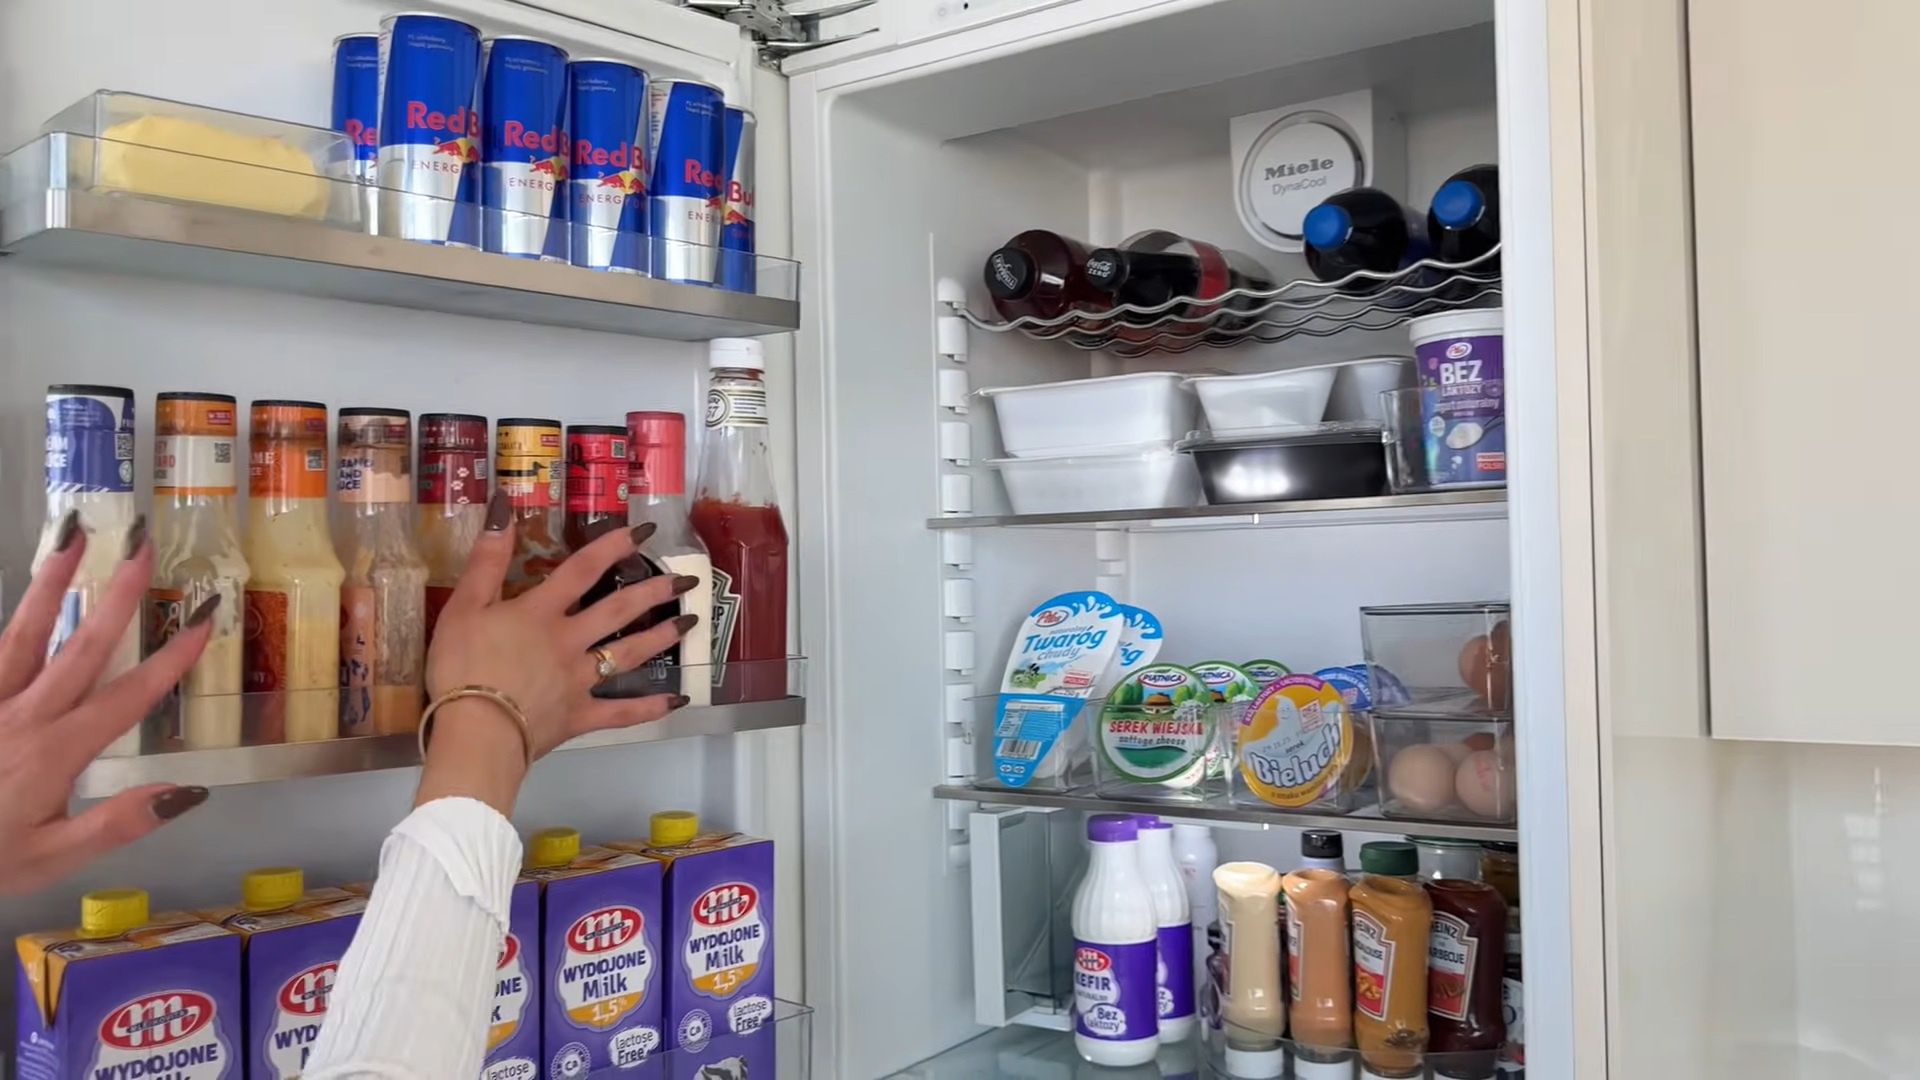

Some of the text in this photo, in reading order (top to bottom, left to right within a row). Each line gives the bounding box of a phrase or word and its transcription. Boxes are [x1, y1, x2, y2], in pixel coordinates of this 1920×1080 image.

[345, 118, 376, 145] Re
[412, 158, 459, 174] ENERG
[1264, 158, 1335, 181] Miele
[509, 177, 553, 191] ENERG
[729, 181, 755, 208] Bul
[1272, 175, 1327, 197] DynaCool
[581, 194, 622, 205] ENERG
[1440, 359, 1483, 385] BEZ
[1022, 626, 1108, 655] Twaróg
[1110, 720, 1149, 734] SEREK
[1249, 723, 1340, 788] Bieluch
[690, 923, 760, 954] WYDOJONE
[563, 949, 647, 984] WYDOJONE
[706, 947, 744, 972] Milk
[583, 972, 628, 1002] Milk
[733, 998, 768, 1018] lactose
[1097, 1007, 1118, 1021] Bez
[615, 1030, 654, 1051] lactose
